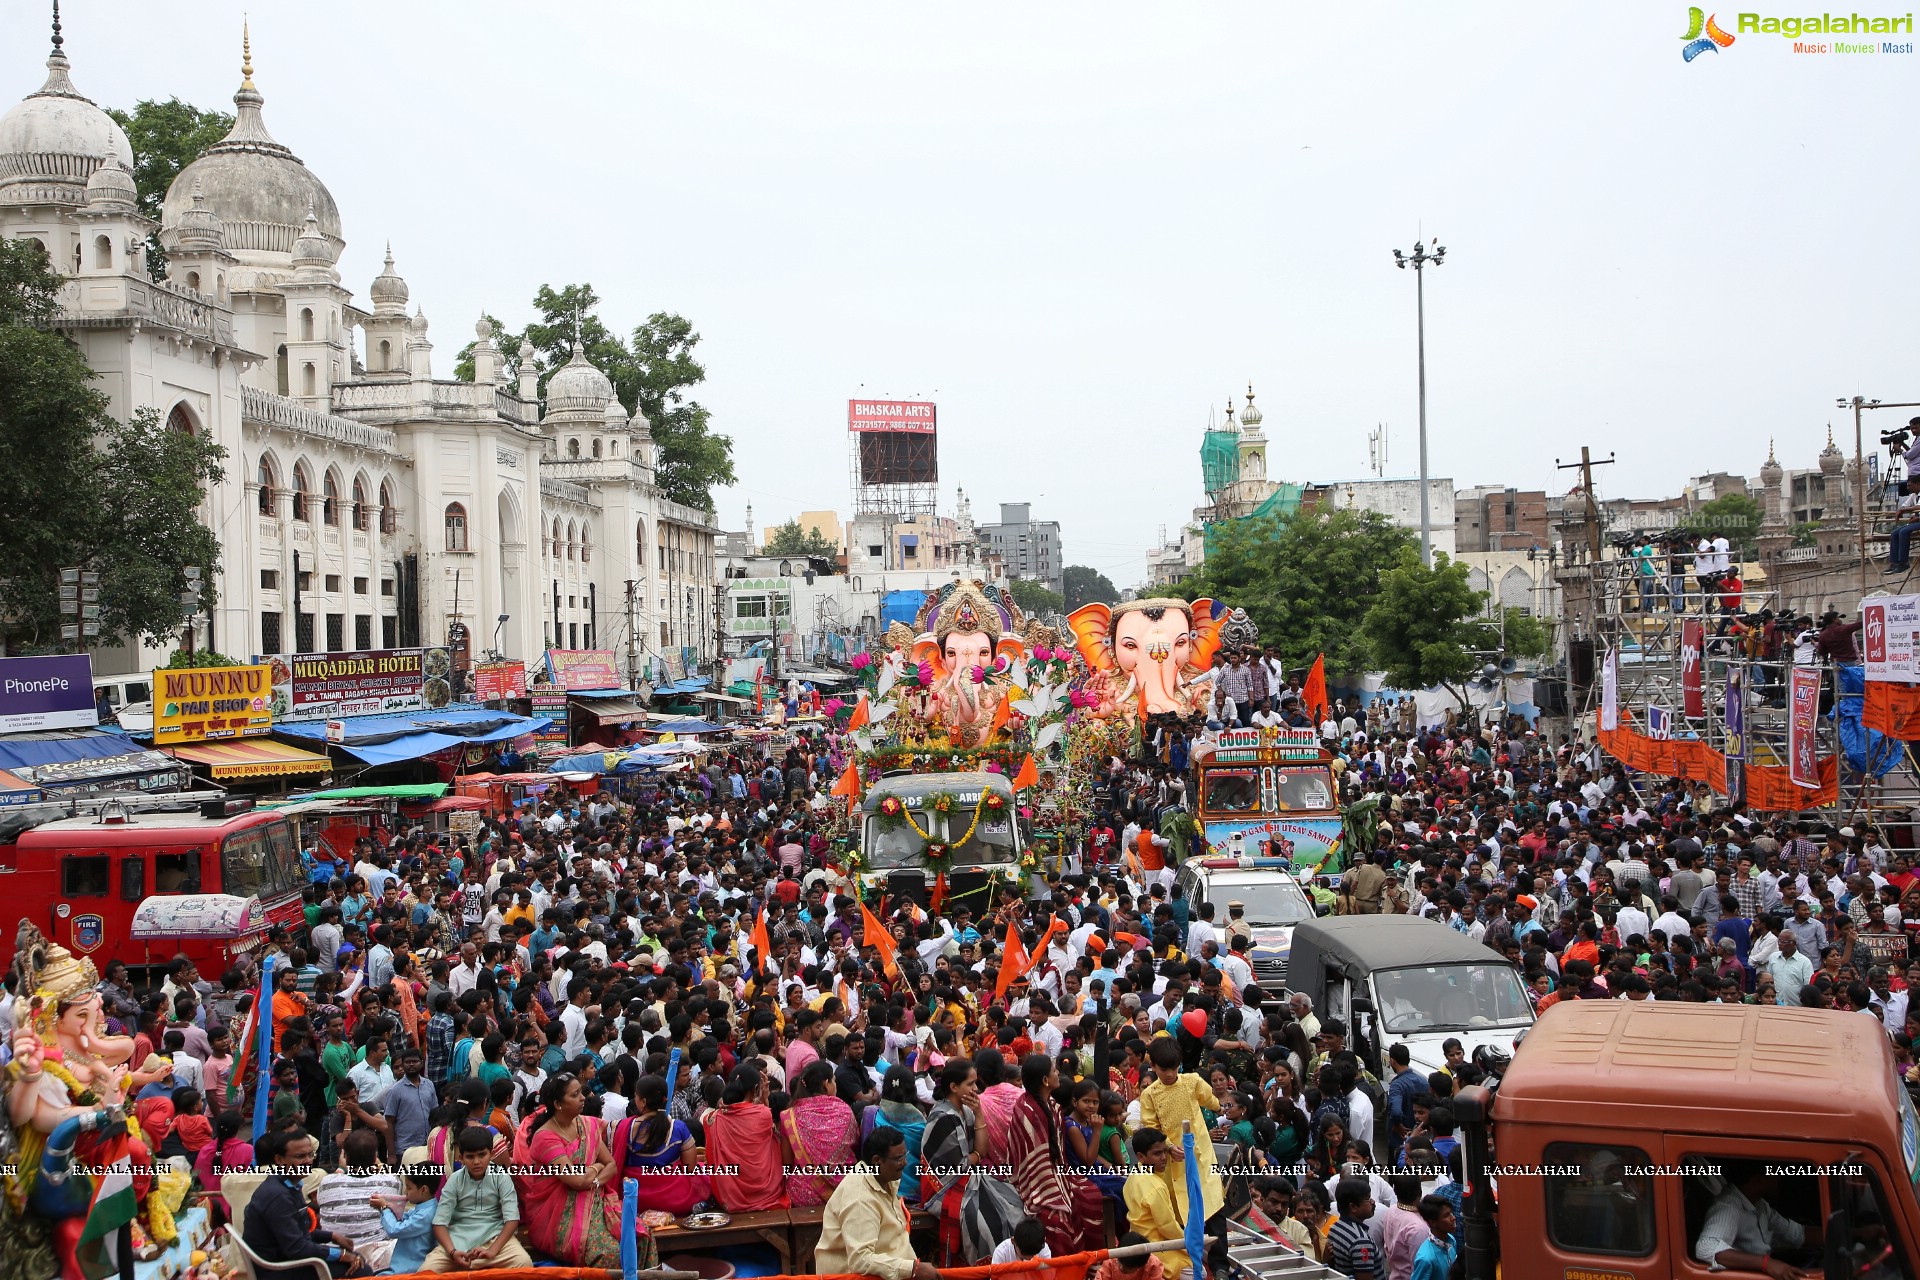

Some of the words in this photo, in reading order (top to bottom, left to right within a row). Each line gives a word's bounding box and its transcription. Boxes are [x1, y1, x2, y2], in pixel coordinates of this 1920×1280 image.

[855, 403, 903, 417] BHASKAR
[904, 404, 931, 417] ARTS
[294, 658, 375, 681] MUQADDAR
[378, 656, 421, 673] HOTEL
[5, 677, 69, 694] PhonePe
[166, 670, 263, 698] MUNNU
[295, 682, 327, 693] KALYANI
[359, 678, 391, 688] CHICKEN
[181, 700, 209, 716] PAN
[213, 697, 250, 713] SHOP
[1218, 731, 1259, 748] GOODS
[1276, 730, 1314, 746] CARRIER
[1279, 748, 1320, 760] TRAILERS
[215, 766, 243, 776] MUNNU
[244, 765, 259, 774] PAN
[260, 764, 280, 774] SHOP
[281, 764, 288, 772] &
[1248, 825, 1281, 841] GANSH
[1281, 824, 1307, 837] UTSAV
[77, 921, 97, 929] FIRE
